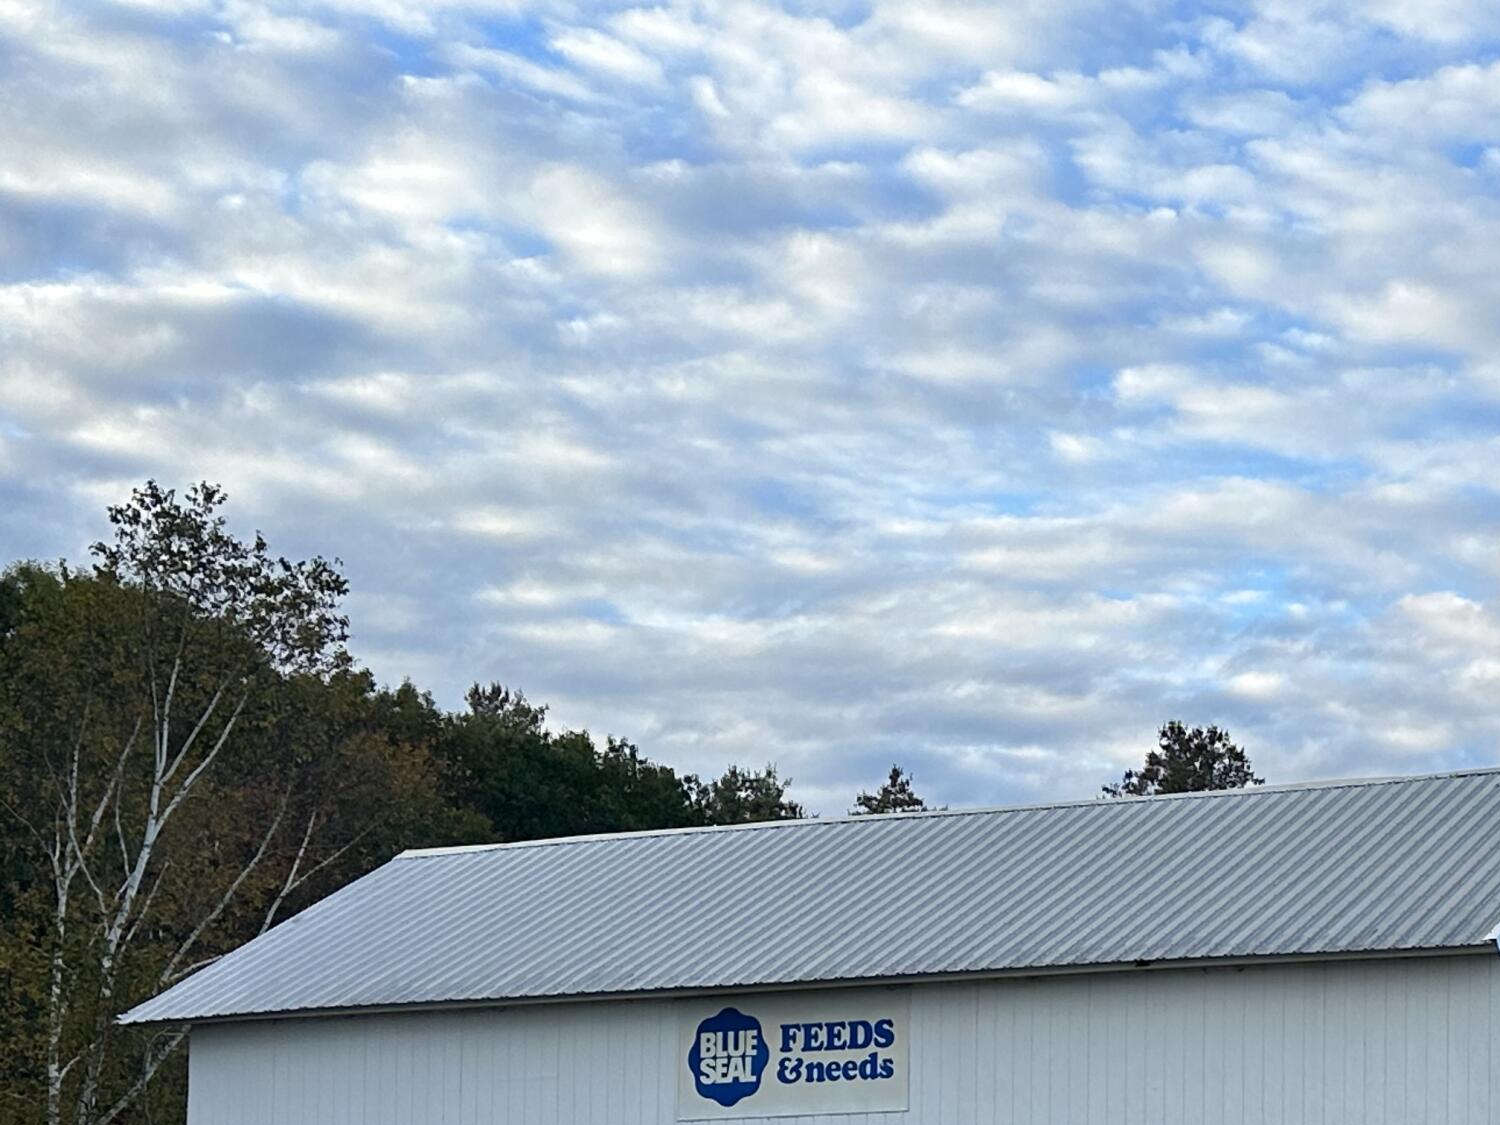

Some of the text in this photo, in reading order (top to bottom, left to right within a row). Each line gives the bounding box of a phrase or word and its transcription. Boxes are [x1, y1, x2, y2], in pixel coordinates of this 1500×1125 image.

[700, 1029, 757, 1058] BLUE
[779, 1019, 895, 1052] FEEDS
[700, 1056, 757, 1085] SEAL
